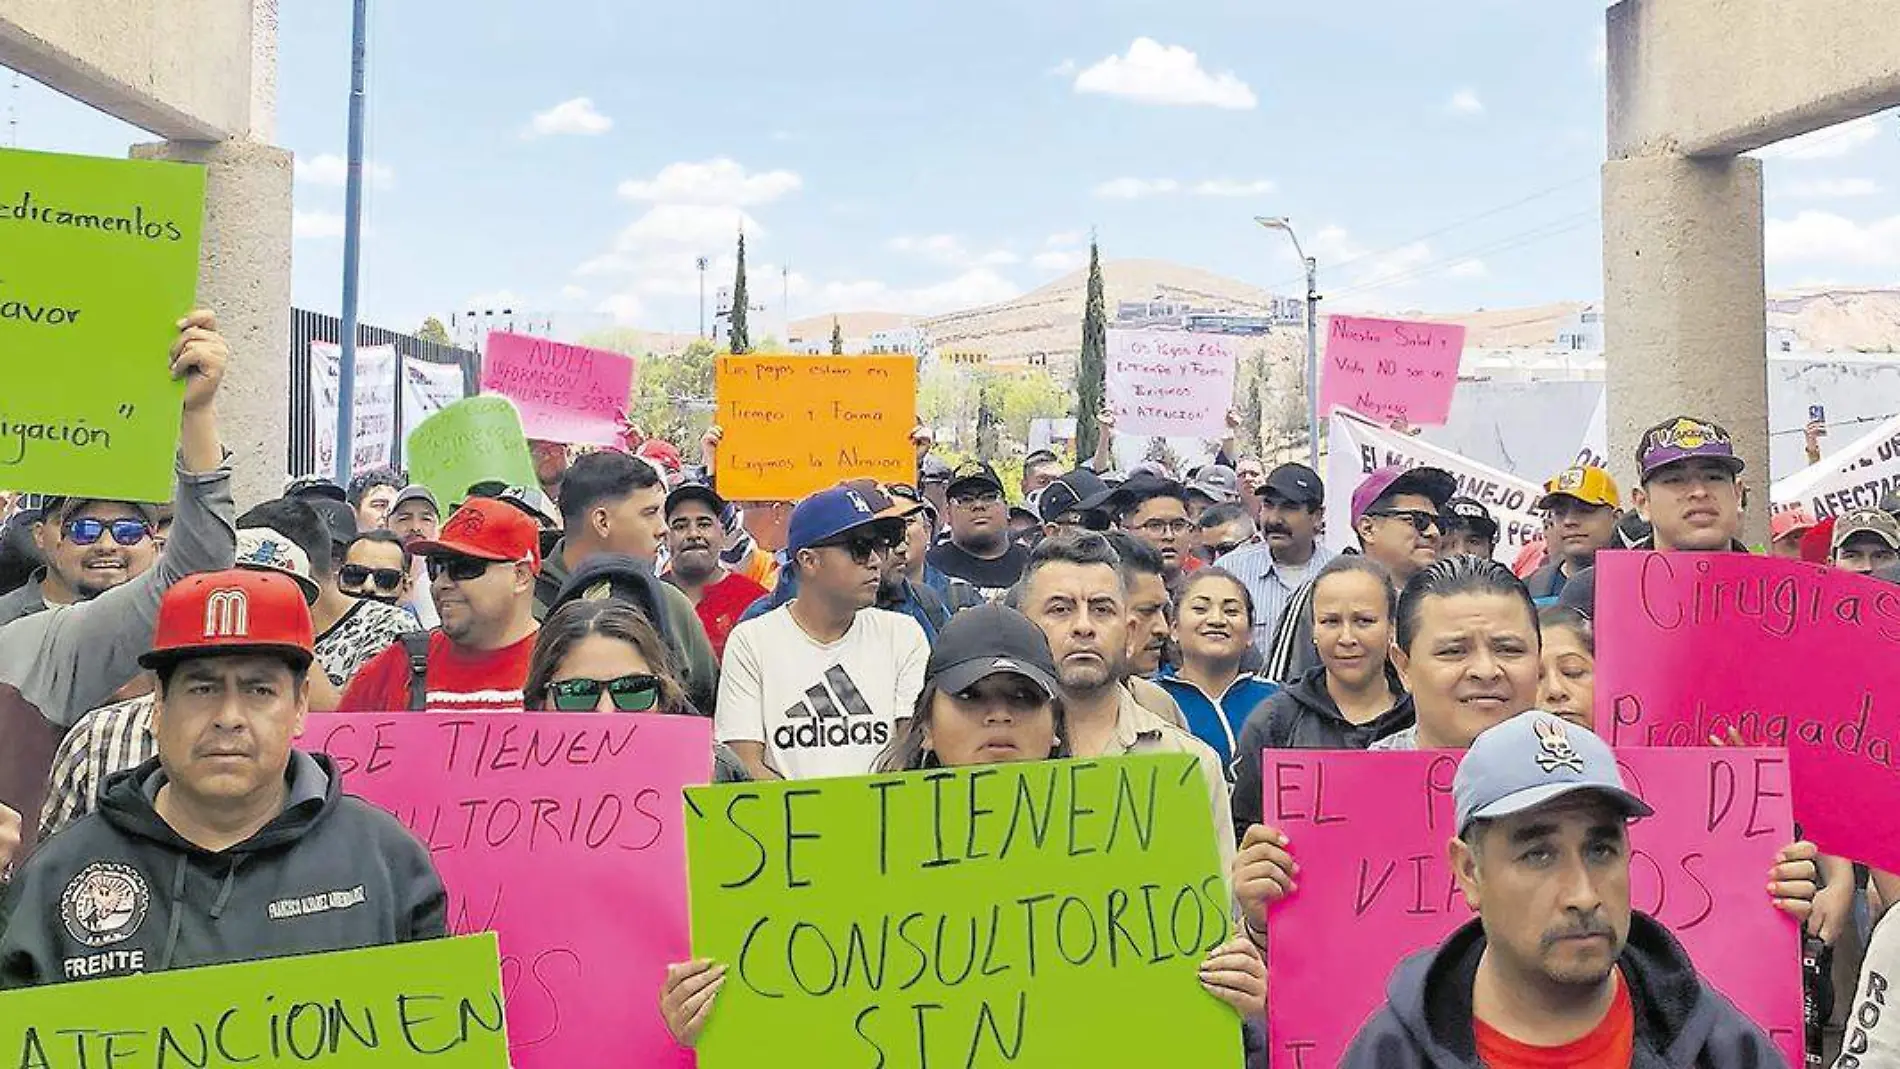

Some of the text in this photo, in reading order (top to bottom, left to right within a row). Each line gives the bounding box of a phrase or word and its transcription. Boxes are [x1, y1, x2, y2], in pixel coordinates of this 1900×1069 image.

[1377, 359, 1396, 376] NO
[324, 720, 638, 777] SE TIENEN
[774, 716, 889, 749] adidas
[1275, 763, 1347, 823] EL
[1707, 758, 1785, 838] DE
[64, 951, 144, 978] FRENTE
[738, 876, 1229, 998] CONSULTORIOS
[396, 993, 505, 1055] EN
